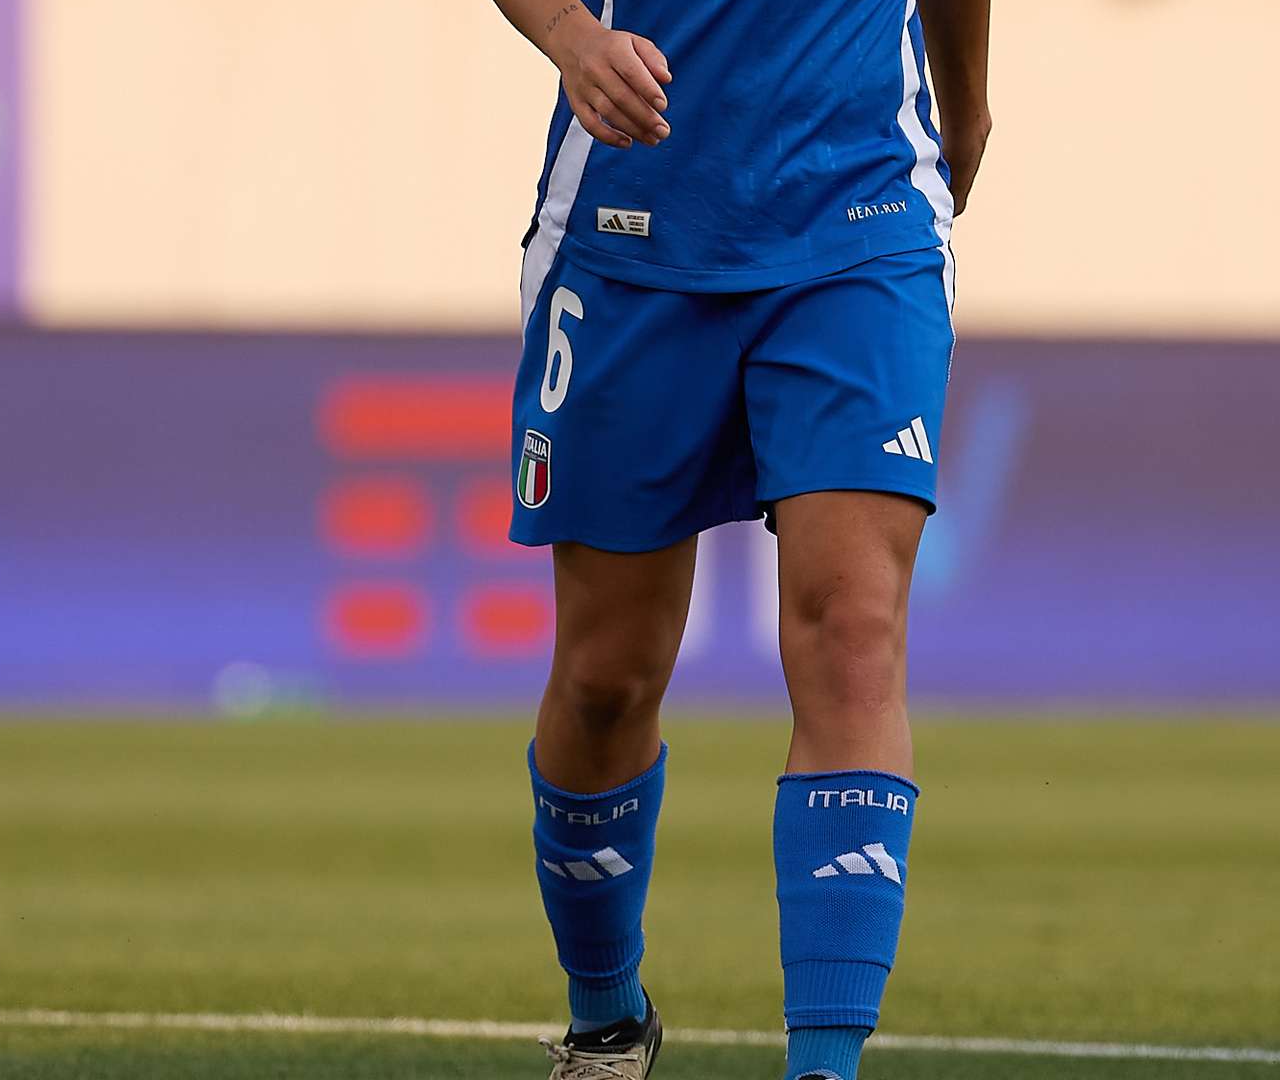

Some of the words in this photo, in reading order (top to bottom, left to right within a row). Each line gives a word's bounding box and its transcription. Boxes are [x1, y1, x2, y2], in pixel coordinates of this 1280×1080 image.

[847, 200, 907, 222] HEAT.RDY
[540, 286, 584, 413] 6
[540, 796, 638, 825] ITALIA
[808, 789, 908, 816] ITALIA
